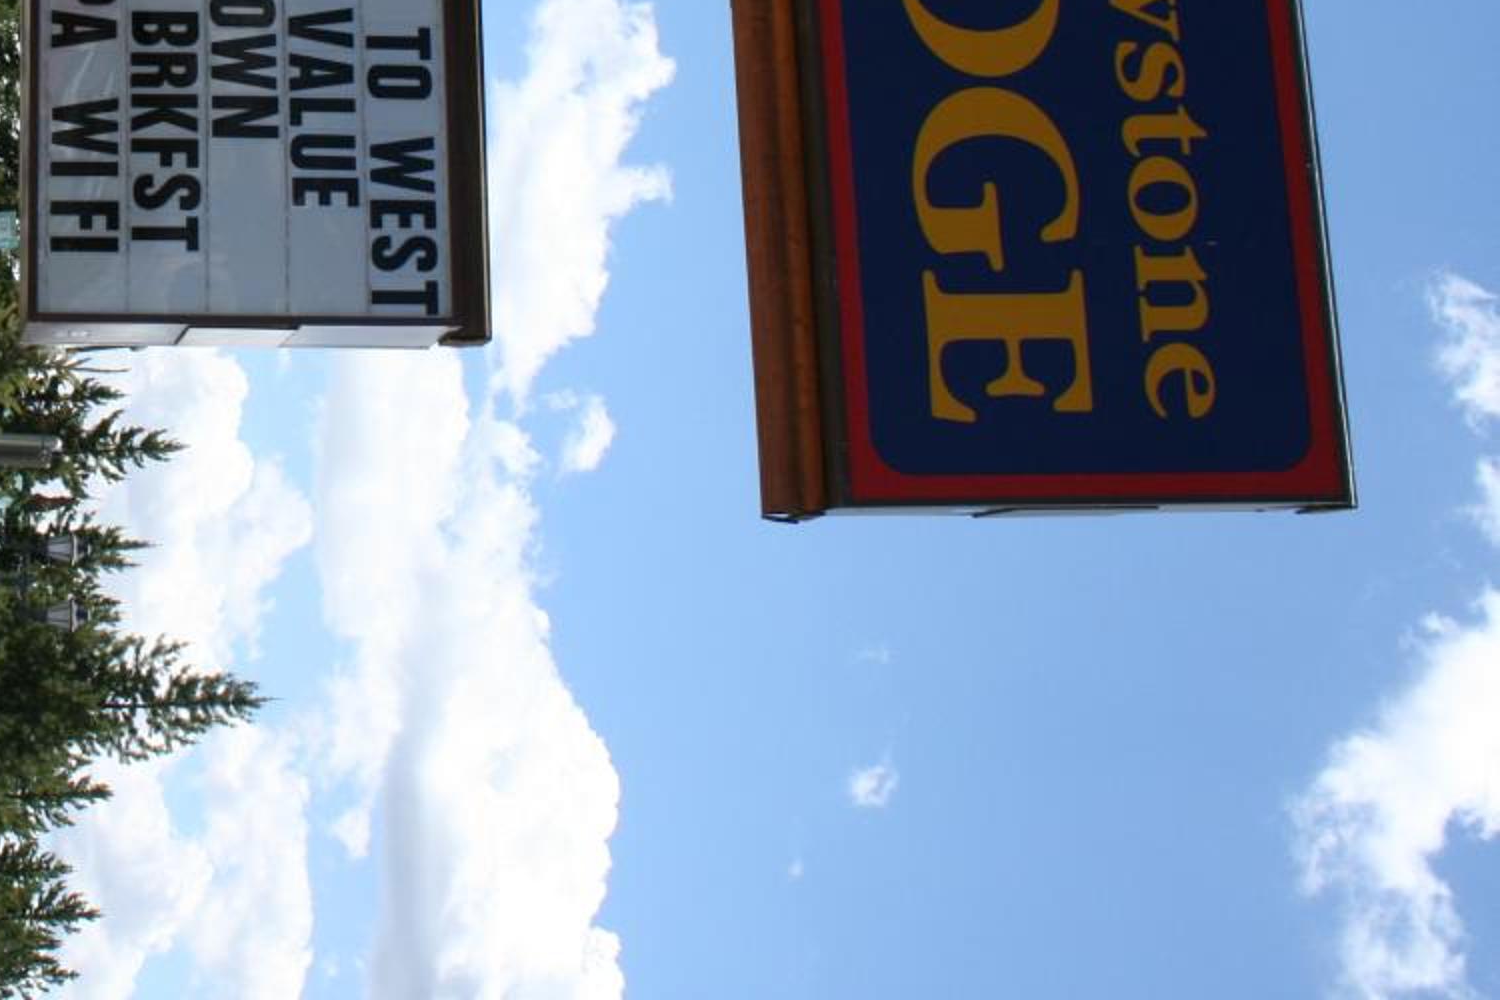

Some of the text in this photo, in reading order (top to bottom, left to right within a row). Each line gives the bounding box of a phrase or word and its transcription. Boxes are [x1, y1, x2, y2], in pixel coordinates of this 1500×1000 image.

[130, 10, 200, 252] BRKFST
[287, 7, 360, 208] VALUE
[365, 27, 433, 100] TO
[369, 136, 439, 316] WEST
